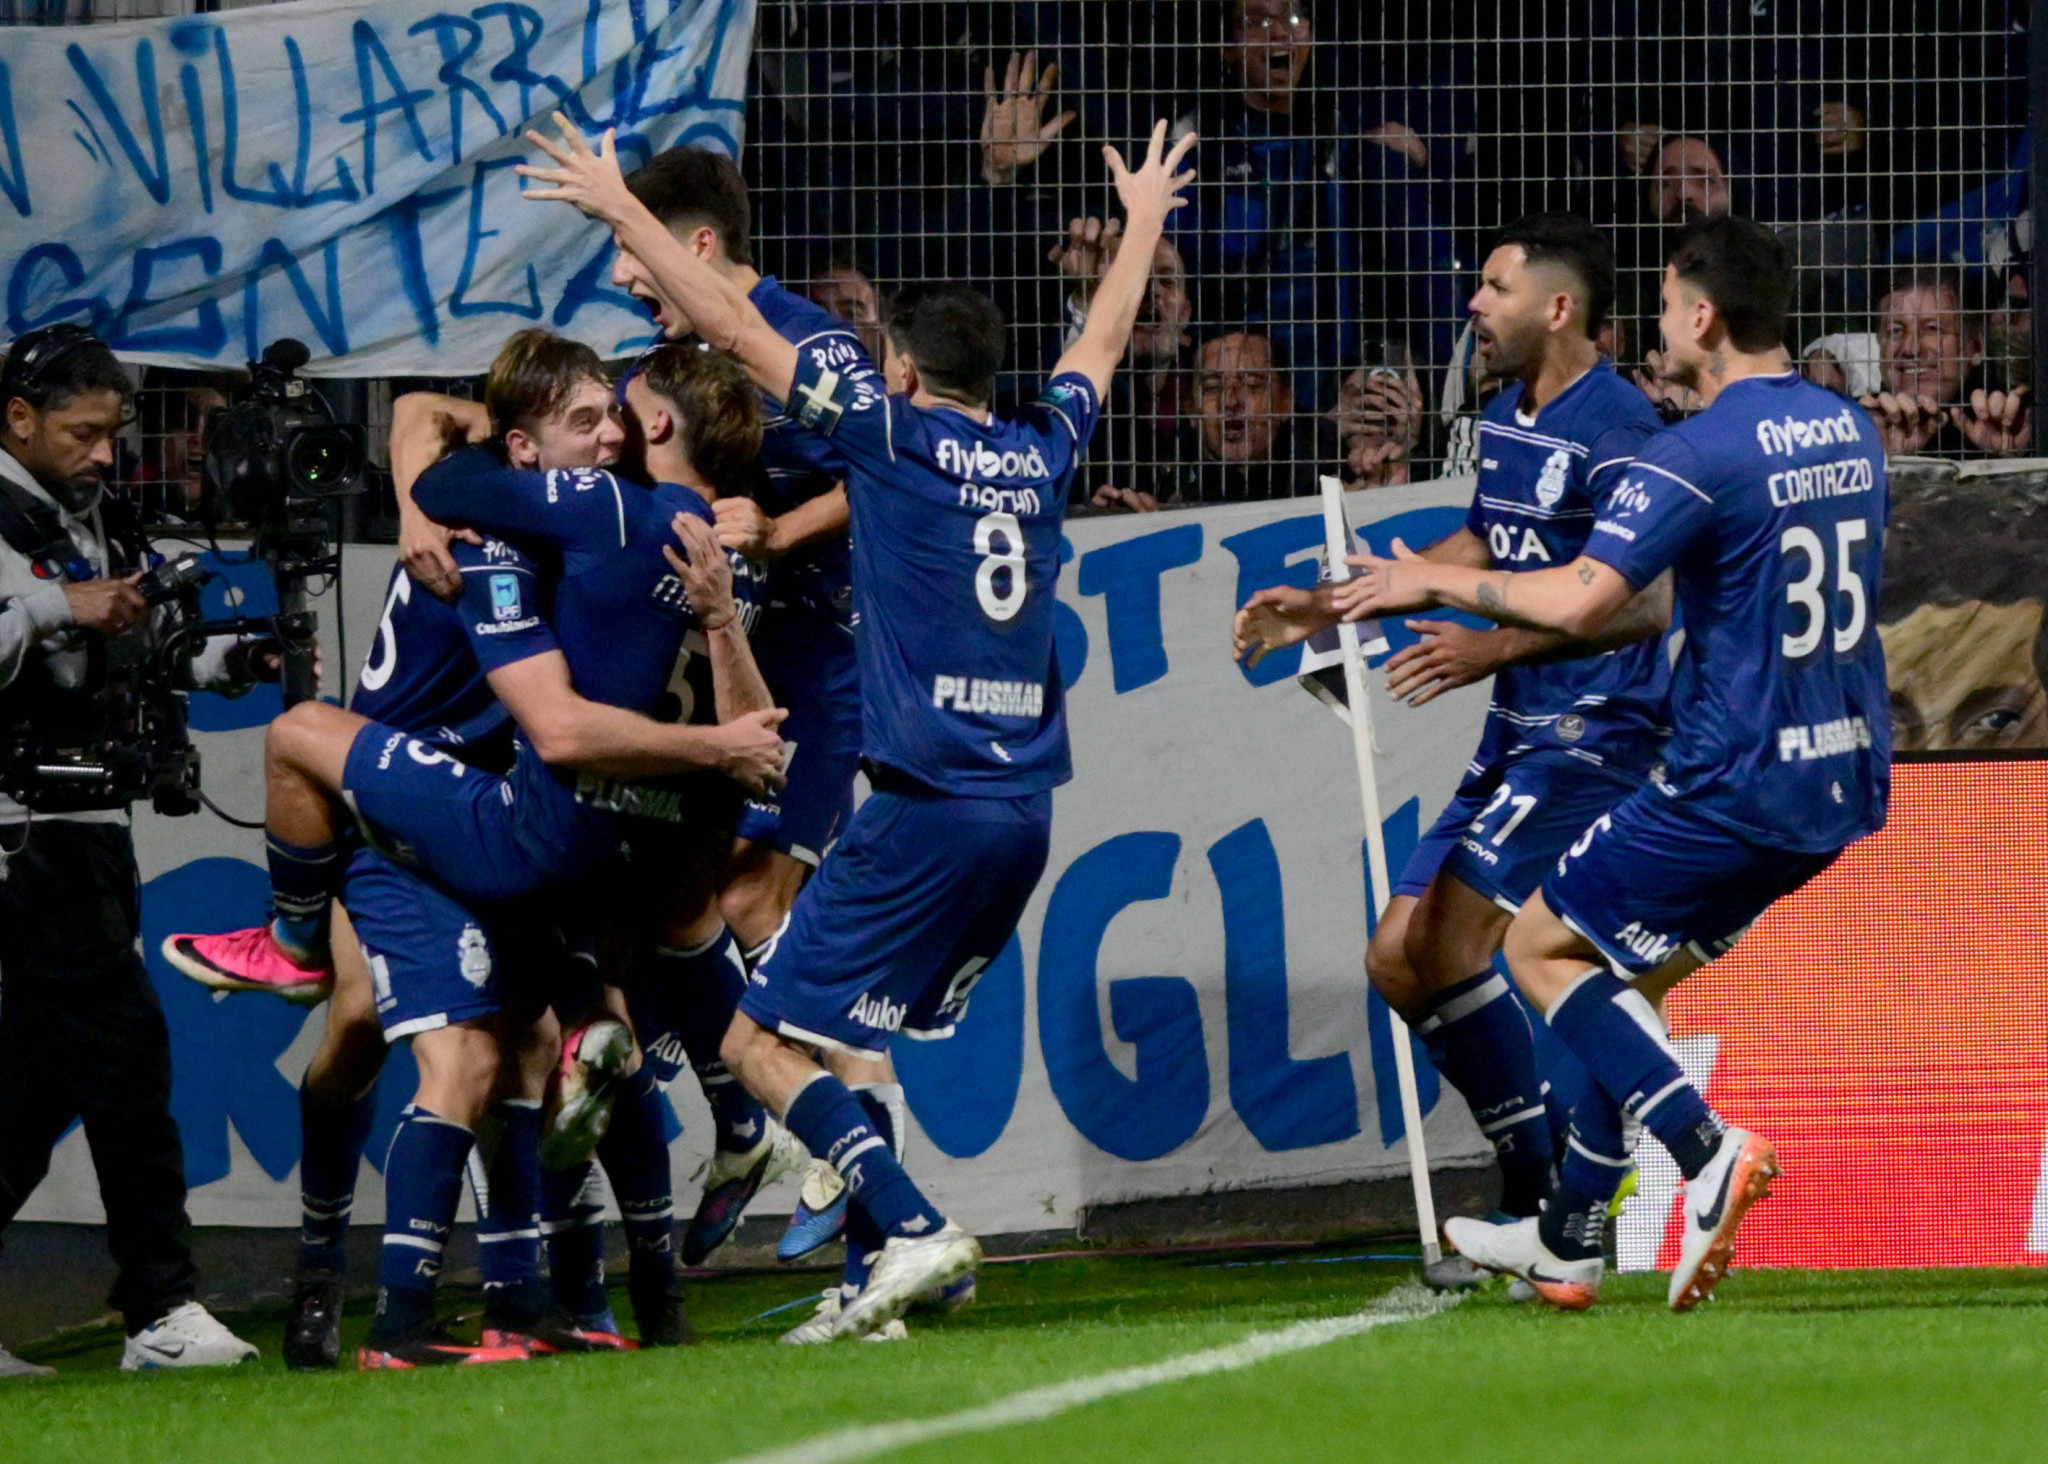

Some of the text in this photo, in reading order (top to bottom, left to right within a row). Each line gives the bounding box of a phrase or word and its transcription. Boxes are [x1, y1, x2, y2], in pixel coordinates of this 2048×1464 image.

[1766, 457, 1874, 508] CORTAZZO
[972, 510, 1028, 622] 8
[1780, 518, 1868, 658] 35
